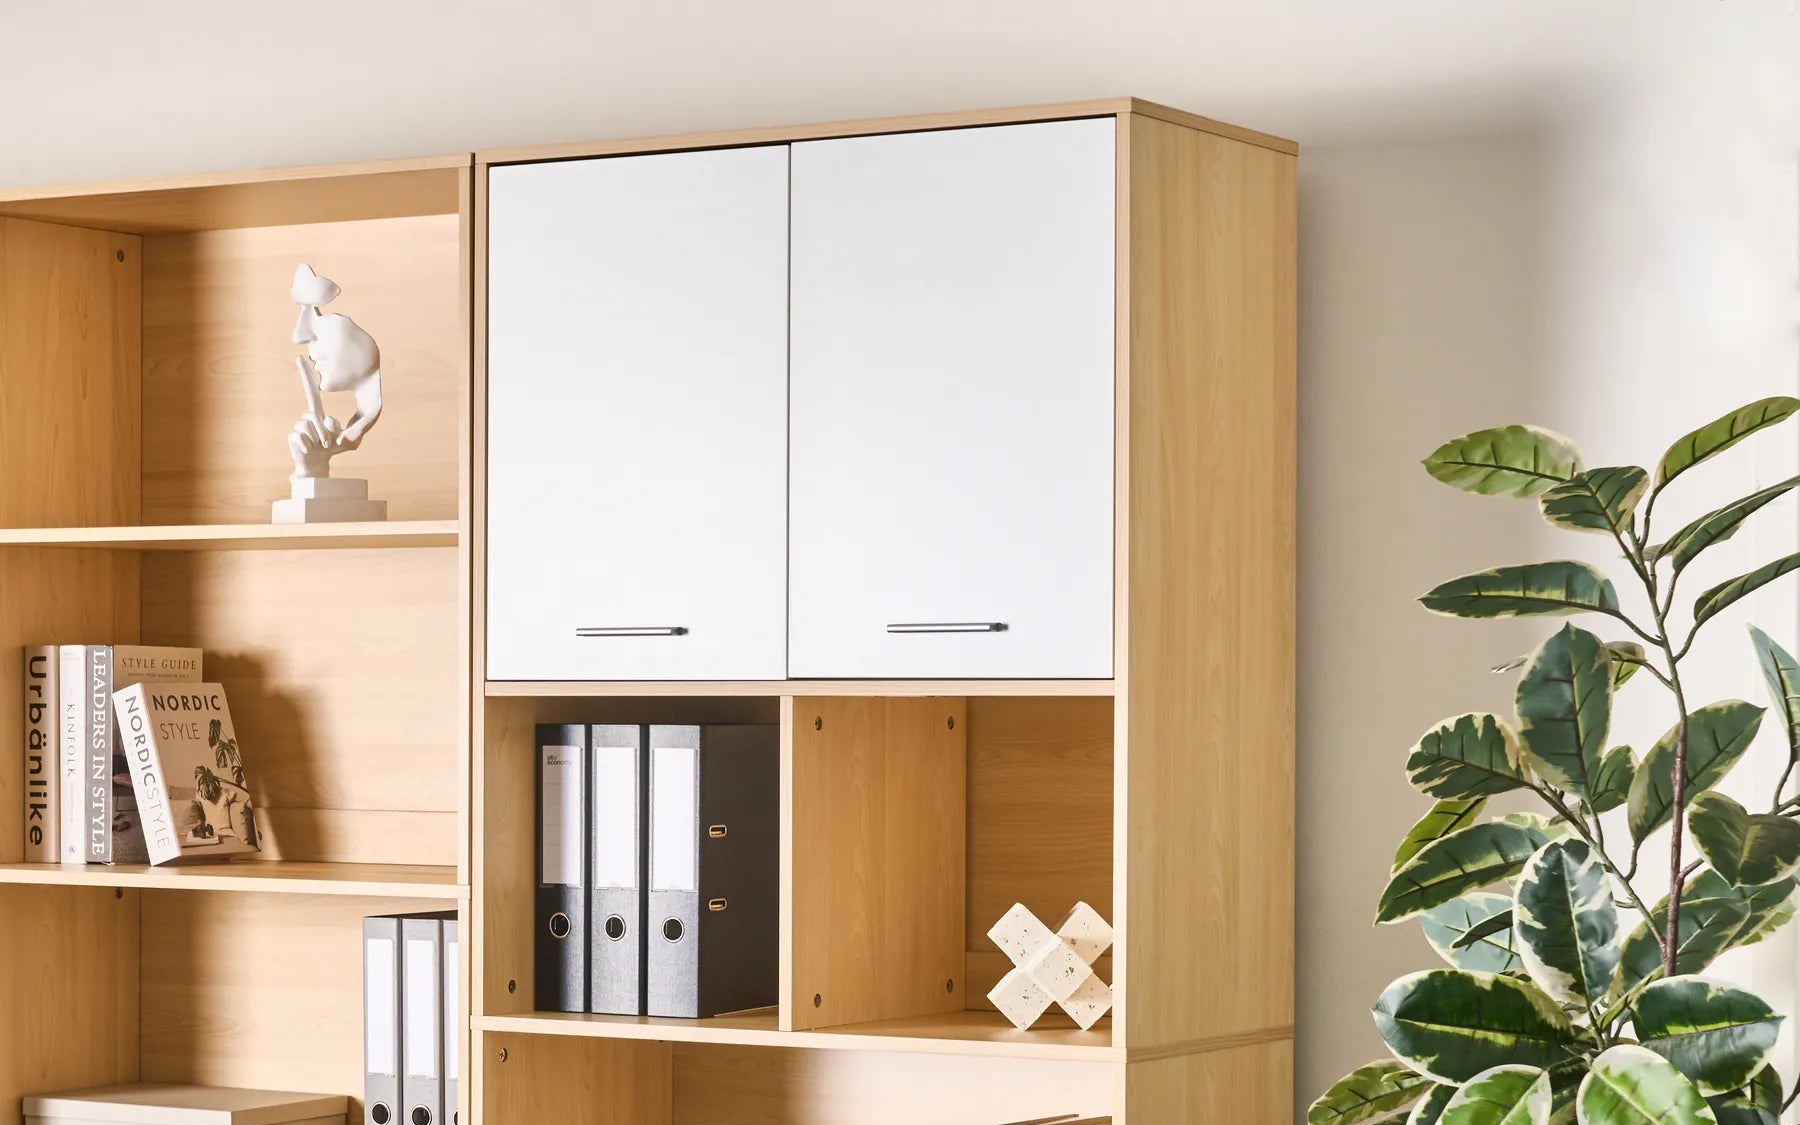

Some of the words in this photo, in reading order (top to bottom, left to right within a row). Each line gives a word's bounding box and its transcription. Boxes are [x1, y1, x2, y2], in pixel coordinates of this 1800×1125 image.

[122, 658, 156, 669] STYLE
[161, 659, 197, 670] GUIDE
[92, 650, 106, 750] LEADERS
[152, 694, 221, 712] NORDIC
[160, 722, 200, 741] STYLE
[28, 655, 47, 846] Urbänlike
[66, 704, 76, 776] KINFOLK
[92, 755, 105, 781] IN
[125, 695, 157, 787] NORDIC
[146, 787, 170, 849] STYLE
[92, 787, 105, 855] STYLE
